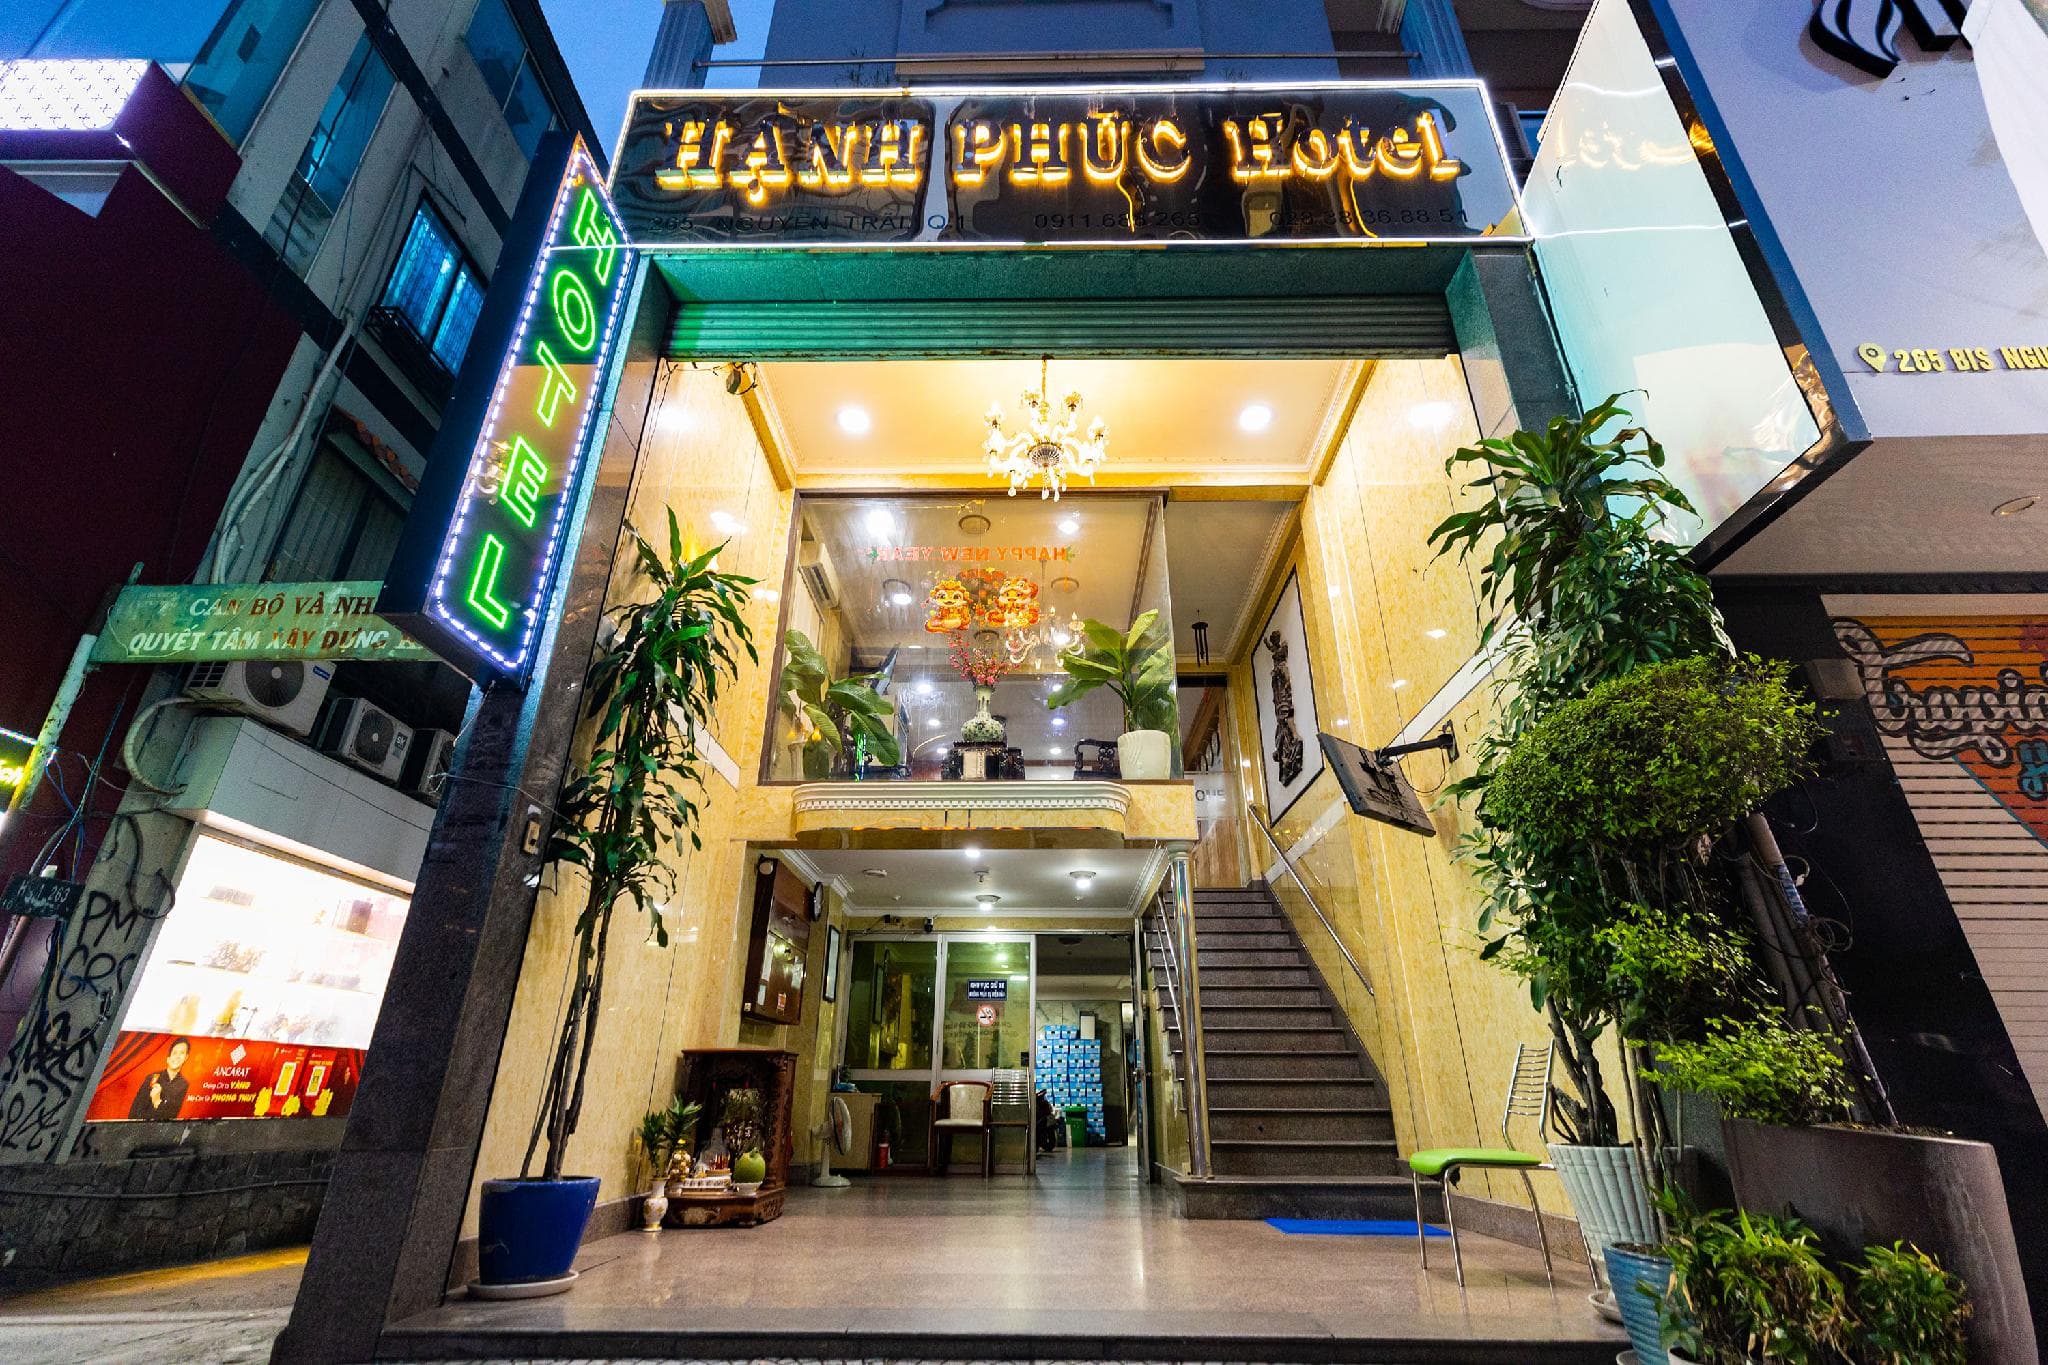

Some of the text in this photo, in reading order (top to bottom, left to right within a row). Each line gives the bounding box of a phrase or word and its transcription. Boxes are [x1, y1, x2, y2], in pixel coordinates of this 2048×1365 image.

[1894, 348, 1947, 373] 265
[1948, 346, 1995, 372] BIS
[466, 186, 617, 630] HOTEL
[210, 626, 261, 651] TÂM
